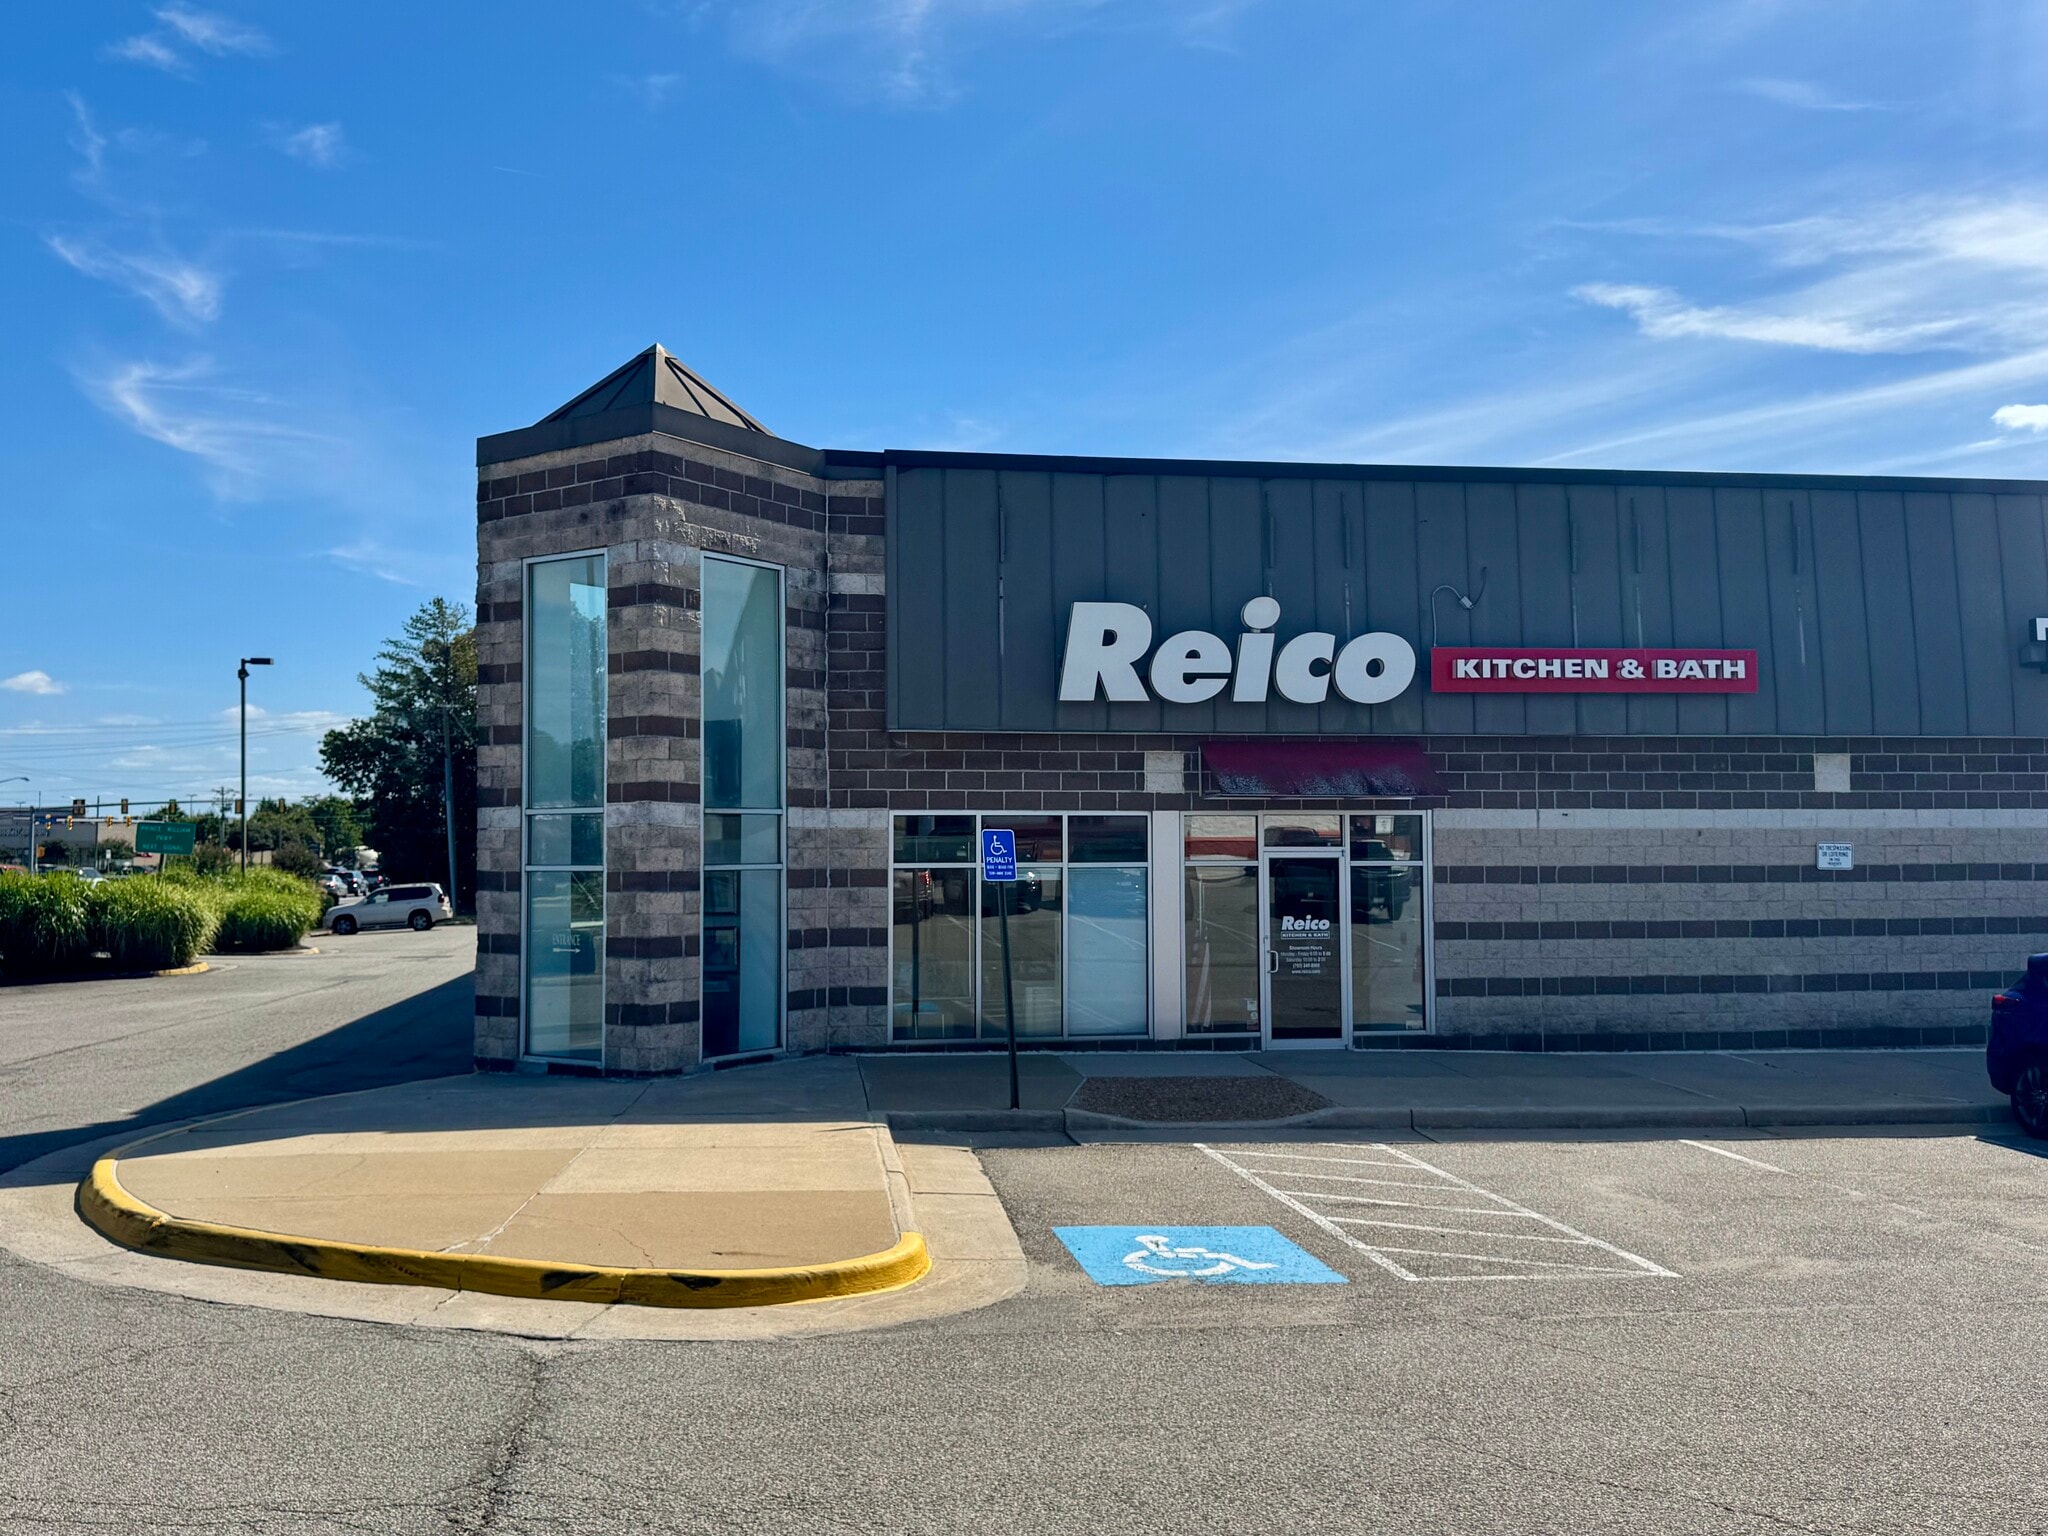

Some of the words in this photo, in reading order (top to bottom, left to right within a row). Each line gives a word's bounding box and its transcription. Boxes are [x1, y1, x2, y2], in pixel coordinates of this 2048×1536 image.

[1059, 596, 1416, 704] Reico
[1454, 658, 1609, 679] KITCHEN
[1617, 658, 1646, 680] &
[1655, 658, 1746, 680] BATH
[1281, 914, 1330, 930] Reico
[553, 933, 580, 946] ENTRANCE
